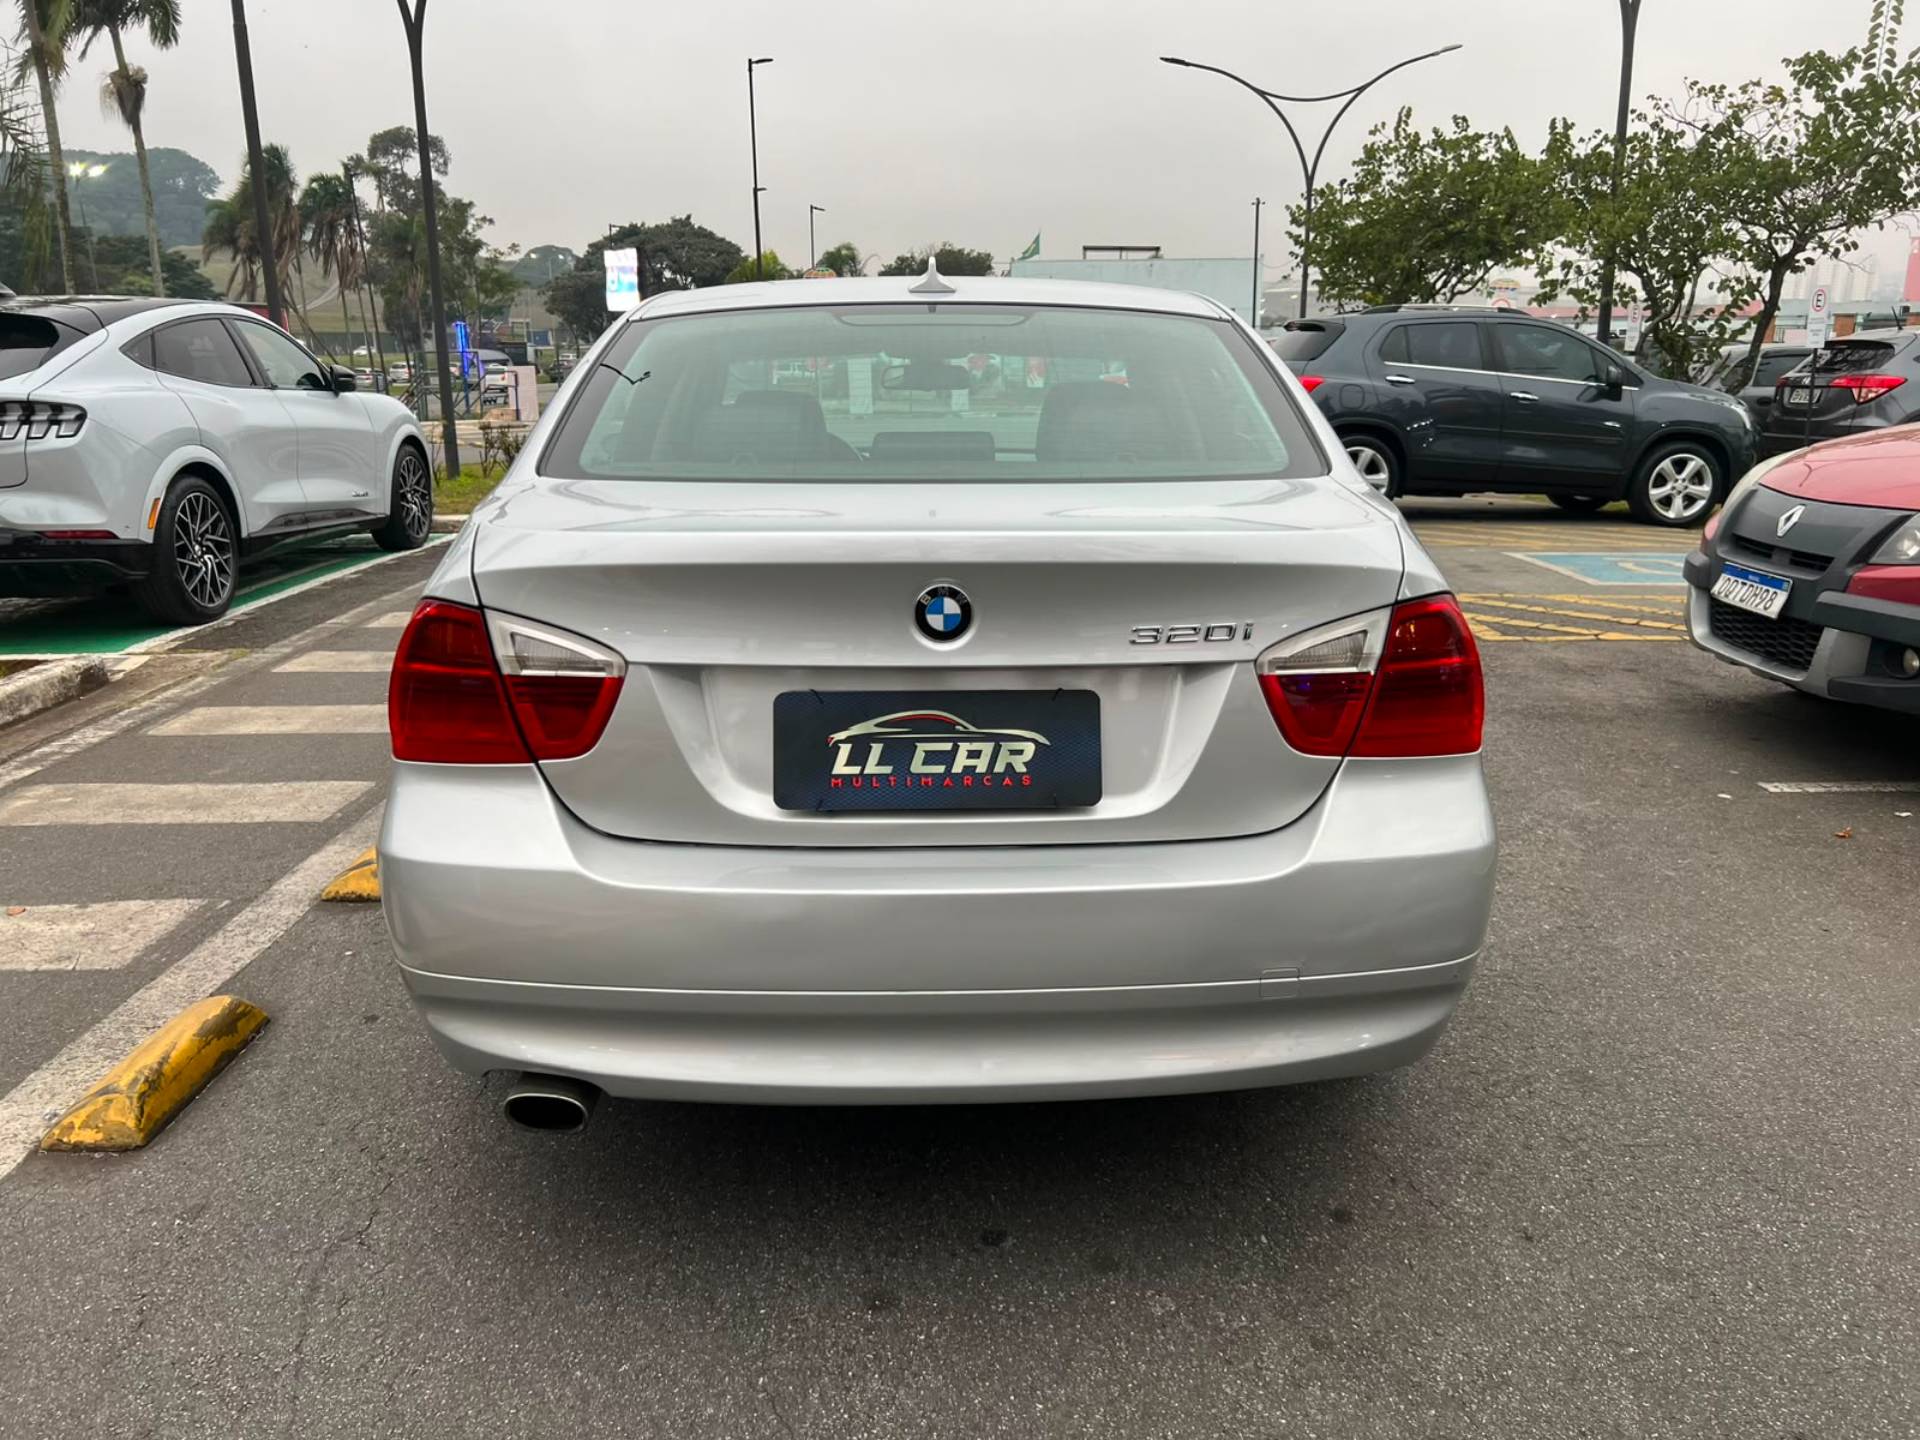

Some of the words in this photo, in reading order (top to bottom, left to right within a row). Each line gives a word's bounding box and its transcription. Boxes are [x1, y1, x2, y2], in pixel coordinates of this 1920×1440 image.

[1129, 620, 1254, 644] 320i
[831, 743, 894, 775] LL
[909, 742, 1036, 774] CAR
[830, 774, 1032, 788] MULTIMARCAS
